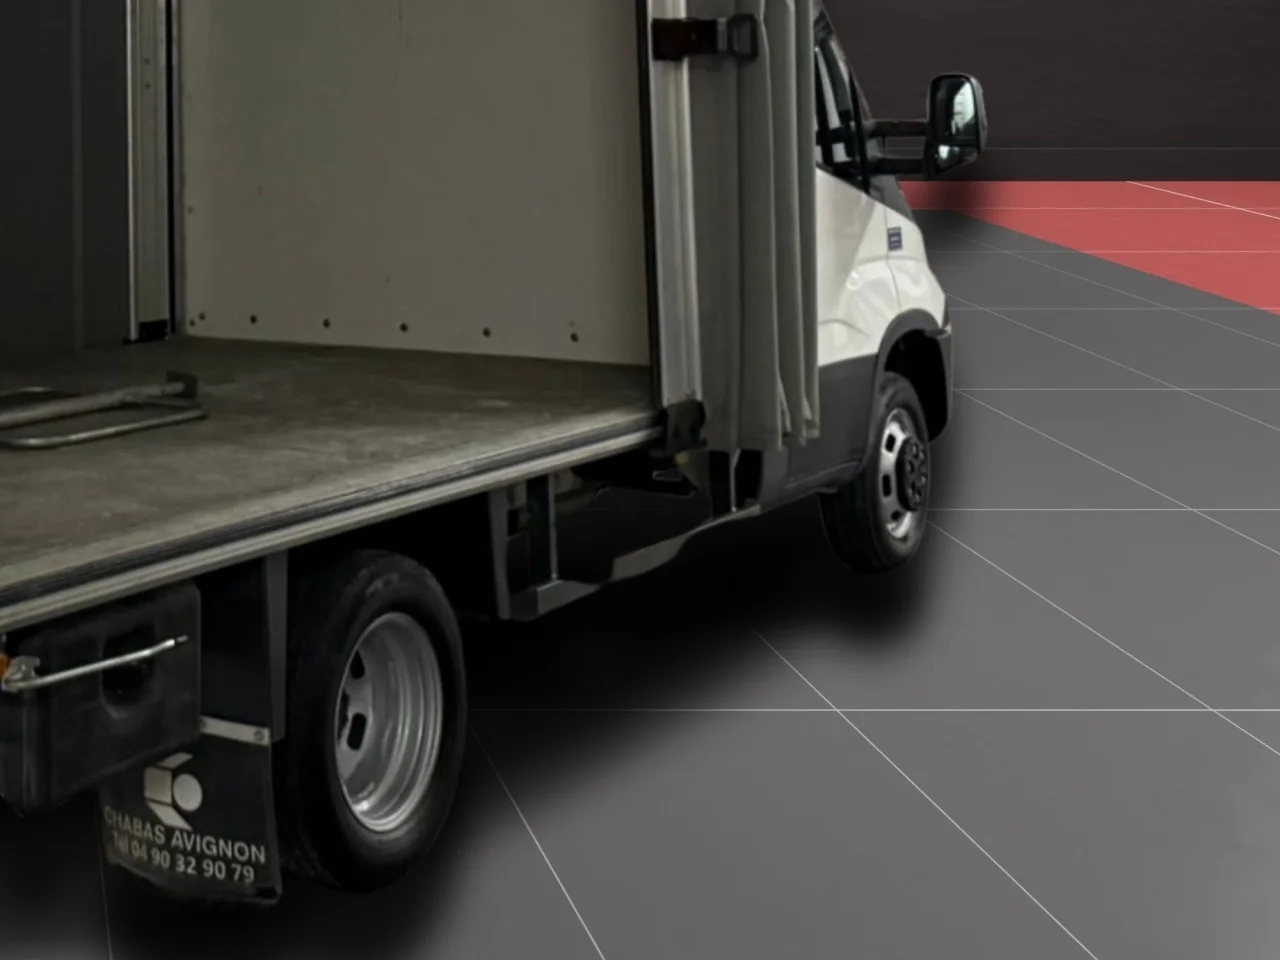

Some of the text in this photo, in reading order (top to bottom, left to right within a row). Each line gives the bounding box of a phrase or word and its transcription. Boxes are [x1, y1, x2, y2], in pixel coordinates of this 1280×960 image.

[104, 805, 266, 865] CHABAS AVIGNON
[131, 840, 148, 861] 04
[151, 847, 170, 869] 90
[175, 853, 197, 875] 32
[202, 858, 226, 880] 90
[231, 863, 255, 884] 79
